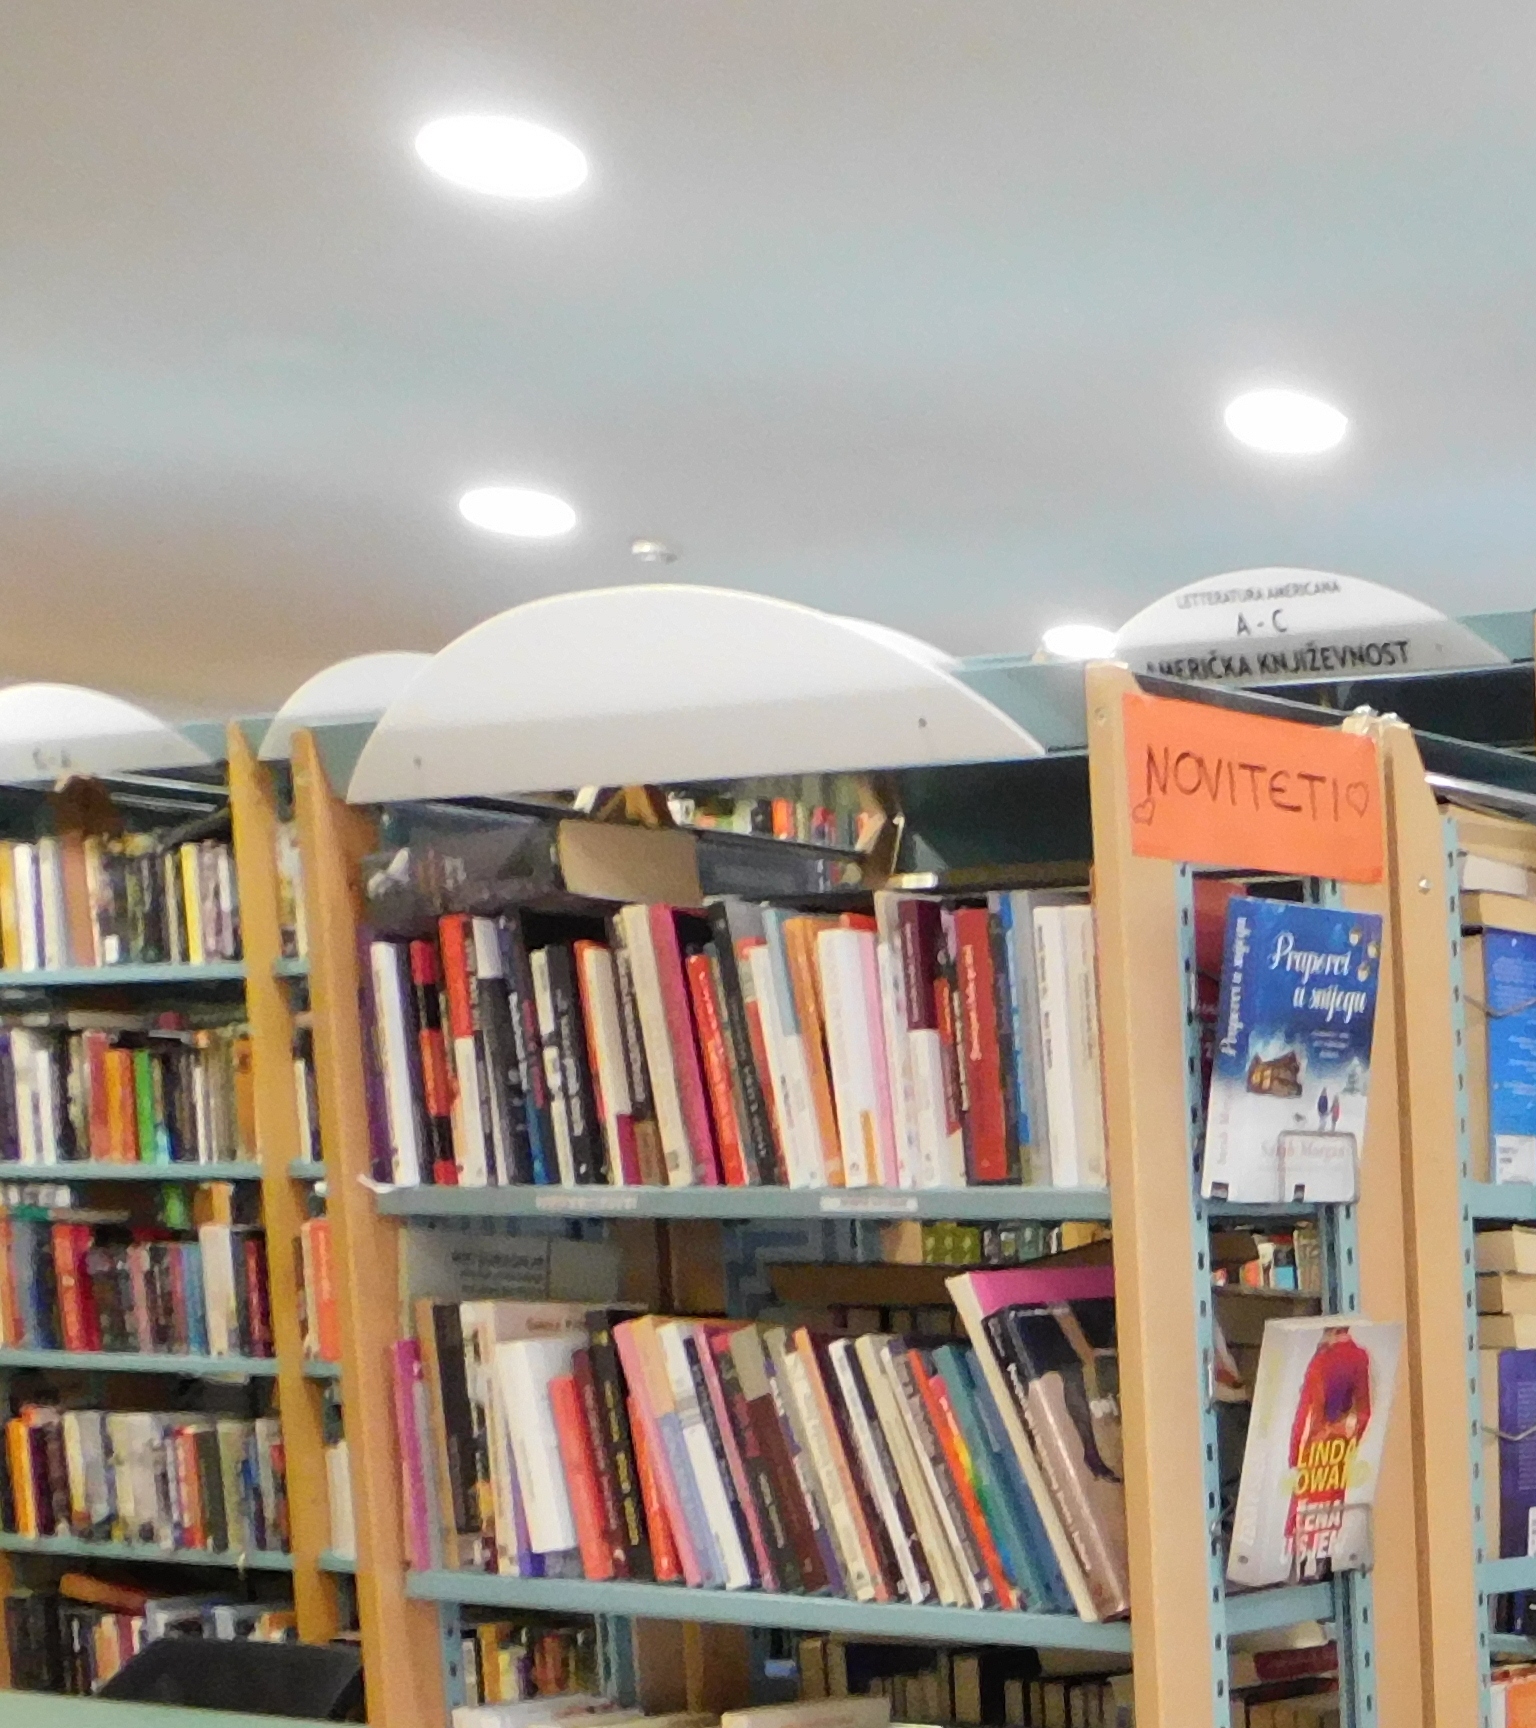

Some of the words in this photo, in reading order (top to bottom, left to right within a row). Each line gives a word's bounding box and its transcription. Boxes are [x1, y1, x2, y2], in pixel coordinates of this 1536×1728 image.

[1267, 579, 1342, 601] AMERICANA
[1236, 611, 1251, 637] A
[1271, 608, 1288, 633] C
[1257, 640, 1411, 676] KNJIŽEVNOST
[1146, 744, 1339, 823] NOVITETI
